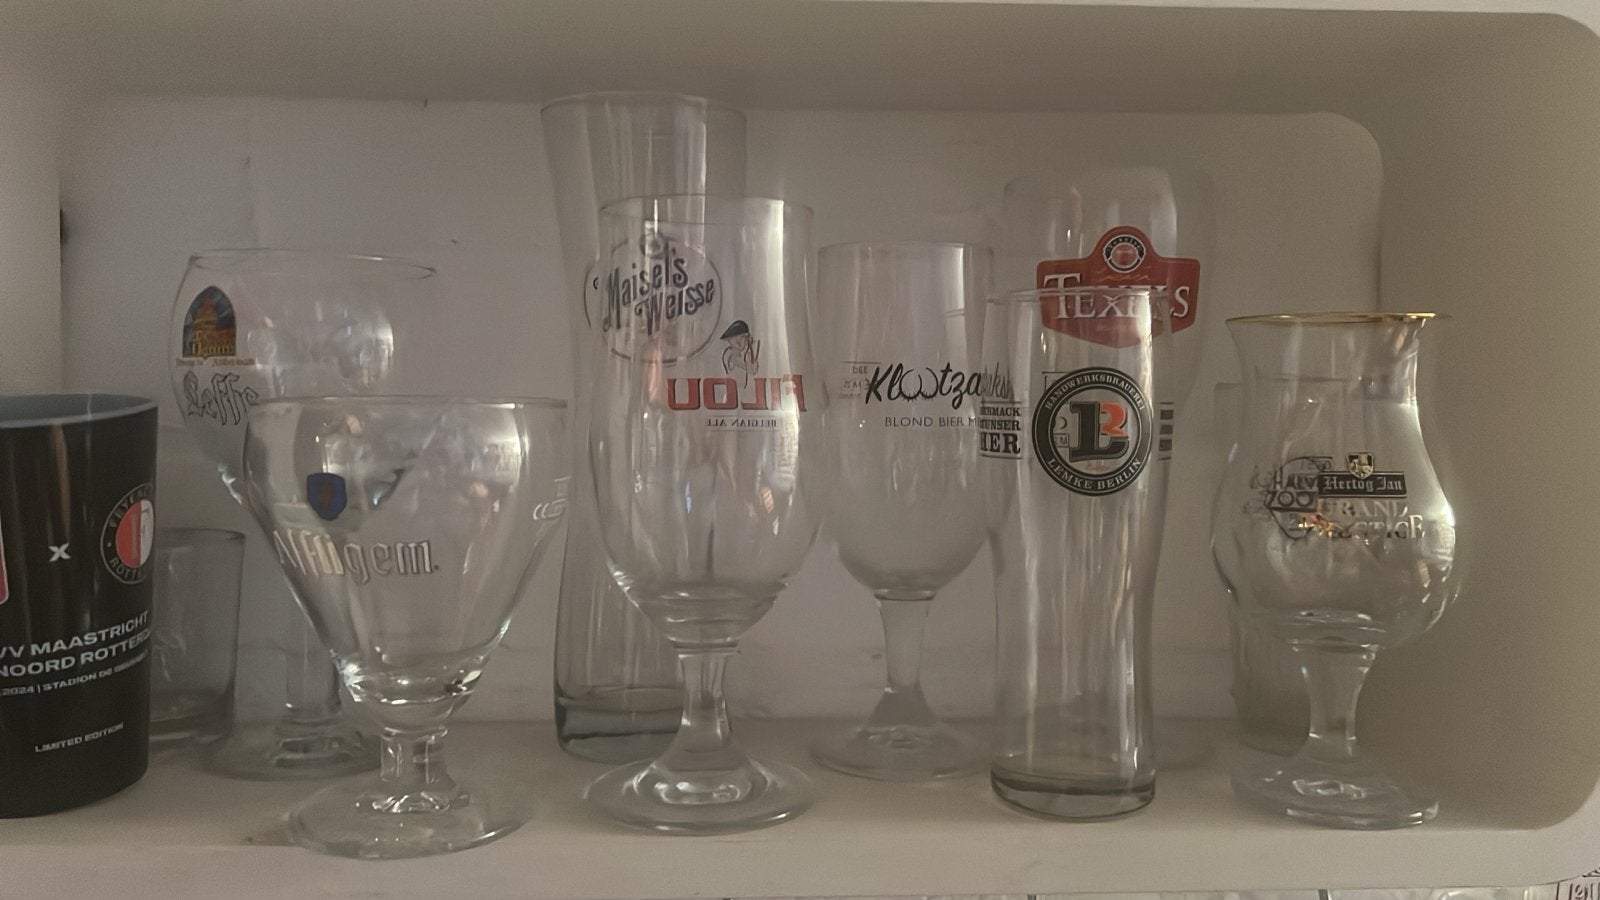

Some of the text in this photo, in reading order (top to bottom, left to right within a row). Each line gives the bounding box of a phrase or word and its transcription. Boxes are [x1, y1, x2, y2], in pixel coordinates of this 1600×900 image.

[635, 278, 716, 336] Weisse
[885, 416, 934, 428] BLOND
[938, 416, 965, 428] BIER
[1048, 458, 1142, 491] LEMKE BERLIN
[1322, 475, 1375, 493] Hertog
[1376, 475, 1403, 491] Jan
[30, 609, 149, 656] MAASTRICHT
[42, 672, 97, 691] STADION
[35, 721, 125, 753] LIMITED EDITION
